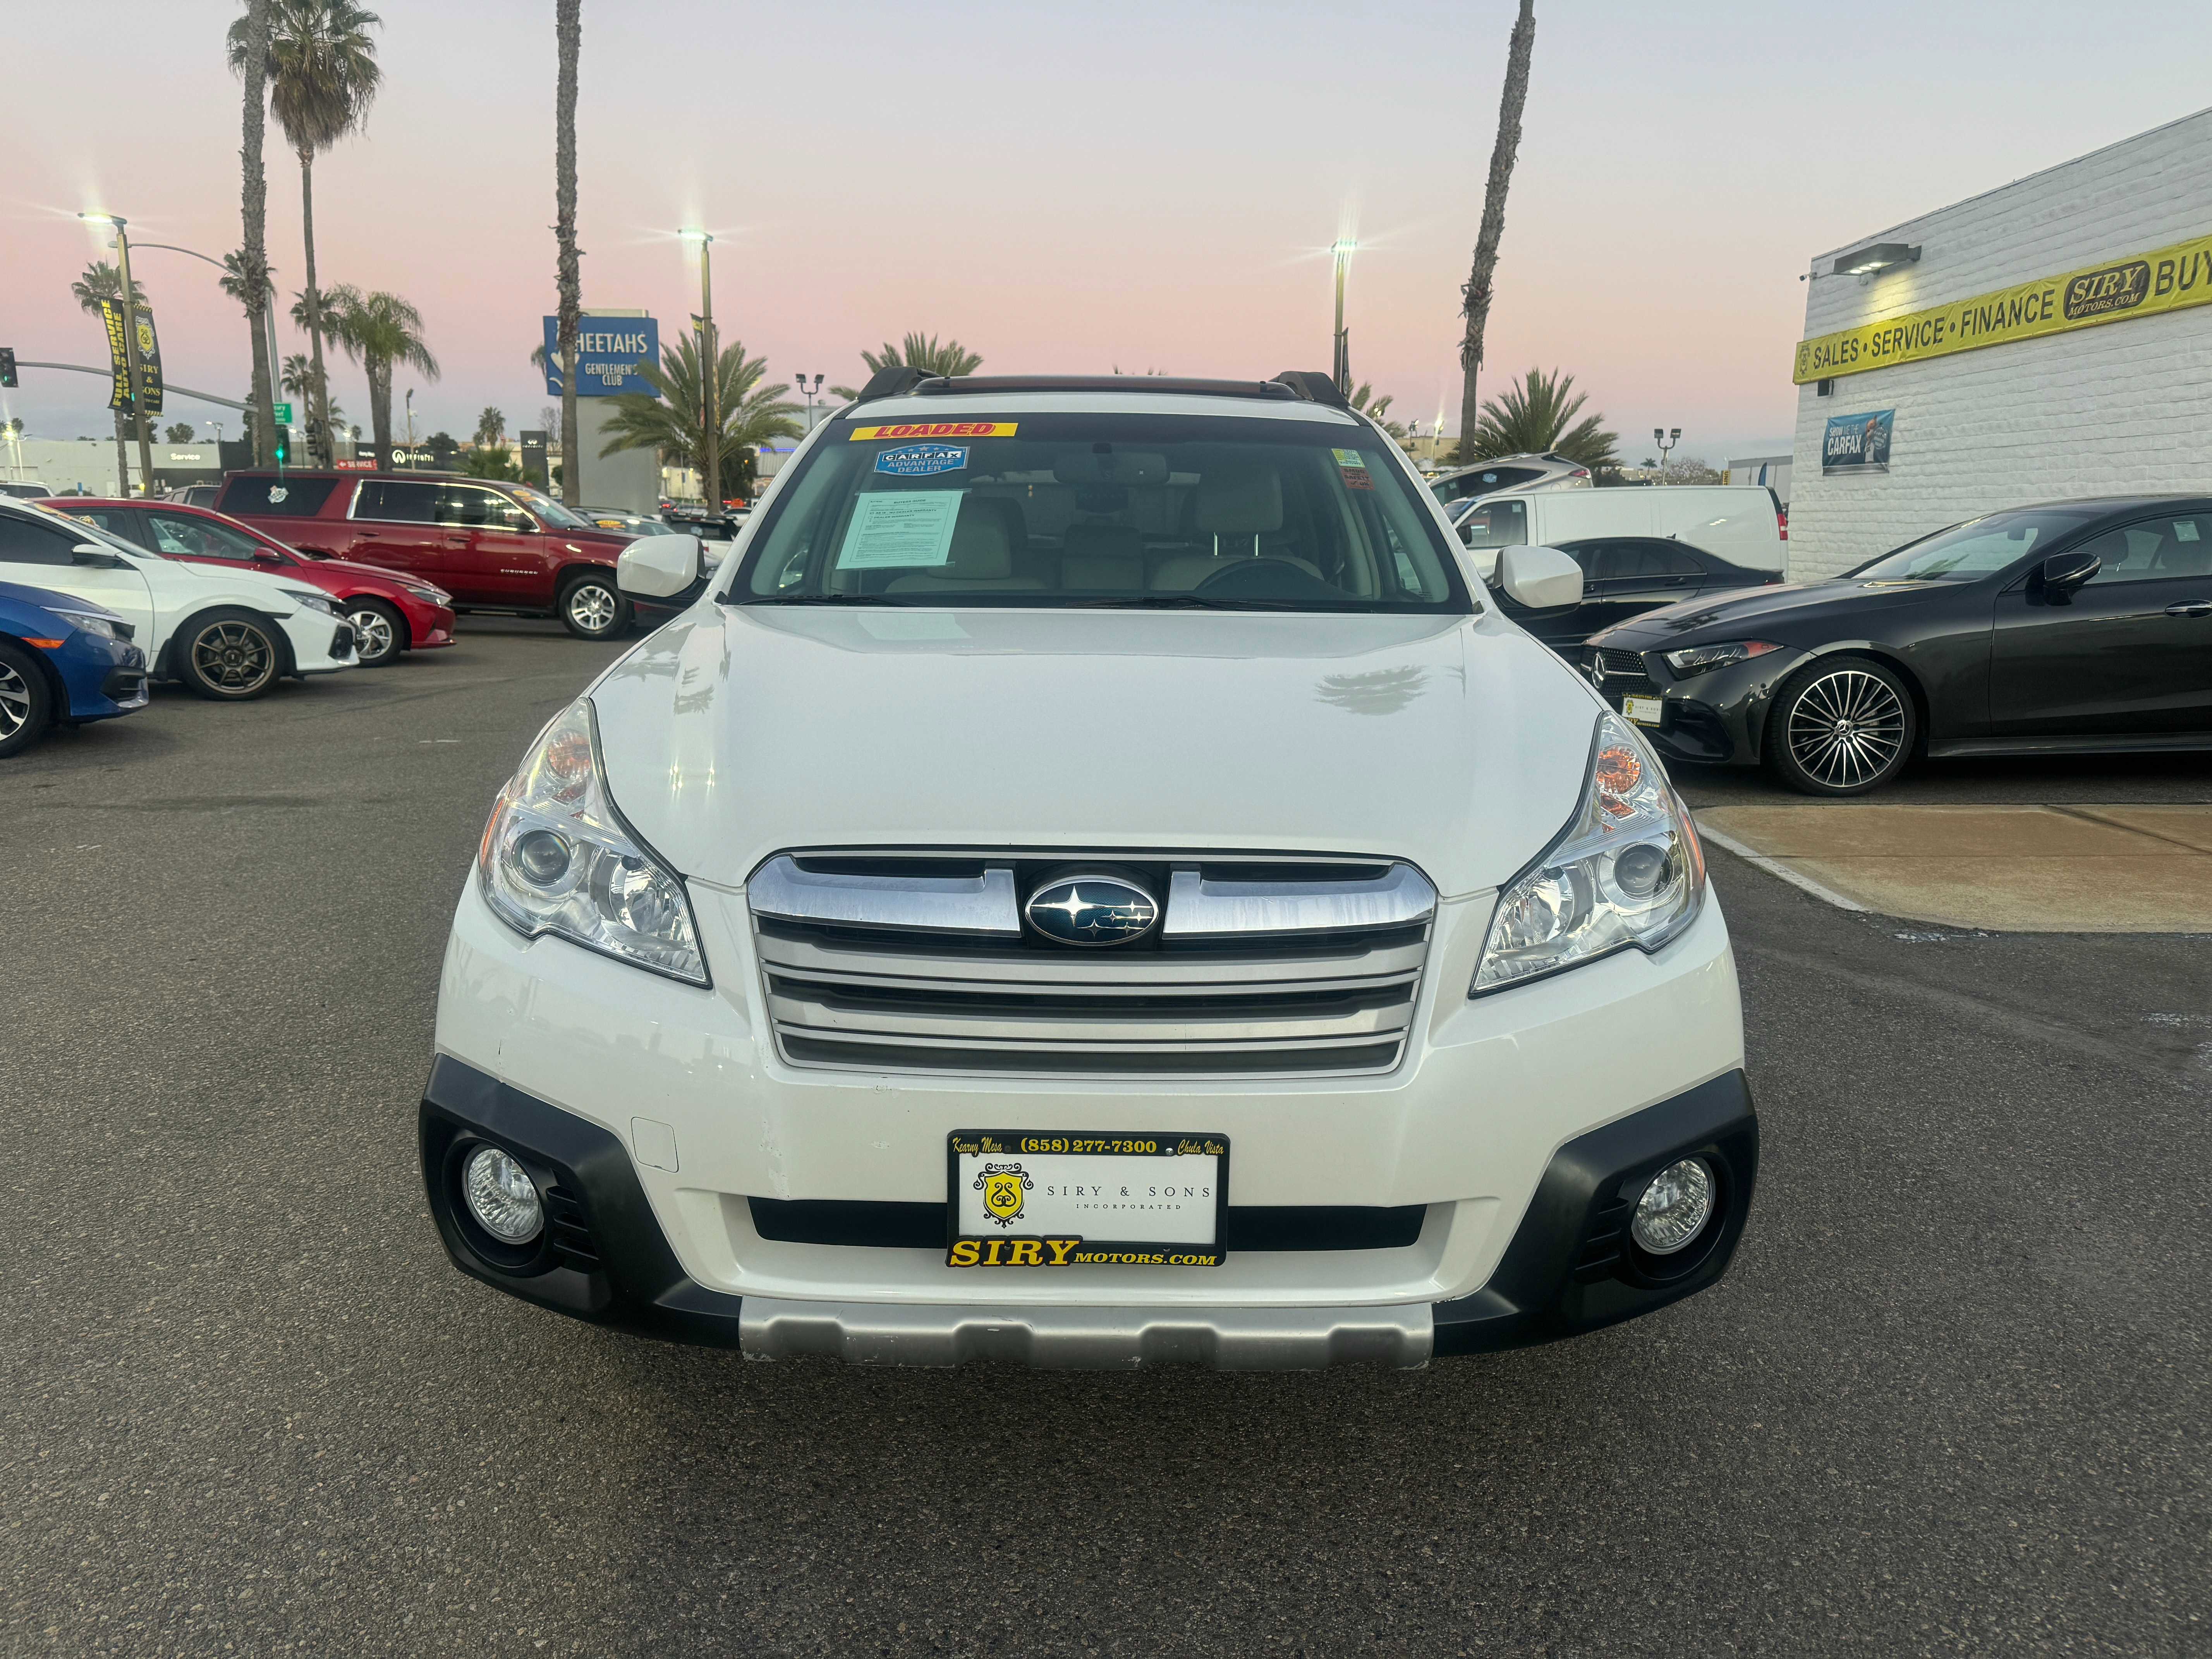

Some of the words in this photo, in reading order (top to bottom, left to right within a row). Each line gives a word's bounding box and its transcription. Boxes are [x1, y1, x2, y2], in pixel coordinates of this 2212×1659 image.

[2069, 264, 2146, 305] SIRY
[2068, 292, 2140, 316] MOTORS.COM
[101, 299, 121, 366] SERVICE
[113, 313, 125, 353] CARE
[1814, 338, 1859, 369] SALES
[1872, 317, 1945, 357] SERVICE
[1960, 289, 2054, 338] FINANCE
[575, 333, 648, 354] HEETAHS
[120, 357, 130, 398] AUTO
[585, 363, 638, 375] GENTLEMEN'S
[112, 373, 123, 407] FULL
[602, 374, 622, 386] CLUB
[873, 423, 996, 438] LOADED
[1829, 426, 1843, 437] SHOW
[1827, 434, 1862, 456] CARFAX
[885, 452, 960, 460] CARFAX
[888, 459, 954, 468] ADVANTAGE
[952, 1137, 979, 1156] Kearny
[981, 1137, 1003, 1153] Mesa
[1020, 1137, 1069, 1153] (858)
[1073, 1139, 1157, 1154] 277-7300
[1177, 1141, 1201, 1155] Chula
[1204, 1142, 1224, 1155] Vista
[1047, 1186, 1102, 1196] SIRY
[1120, 1186, 1130, 1197] &
[1149, 1186, 1210, 1197] SONS
[950, 1239, 1080, 1266] SIRY
[1073, 1252, 1217, 1266] MOTORS.COM
